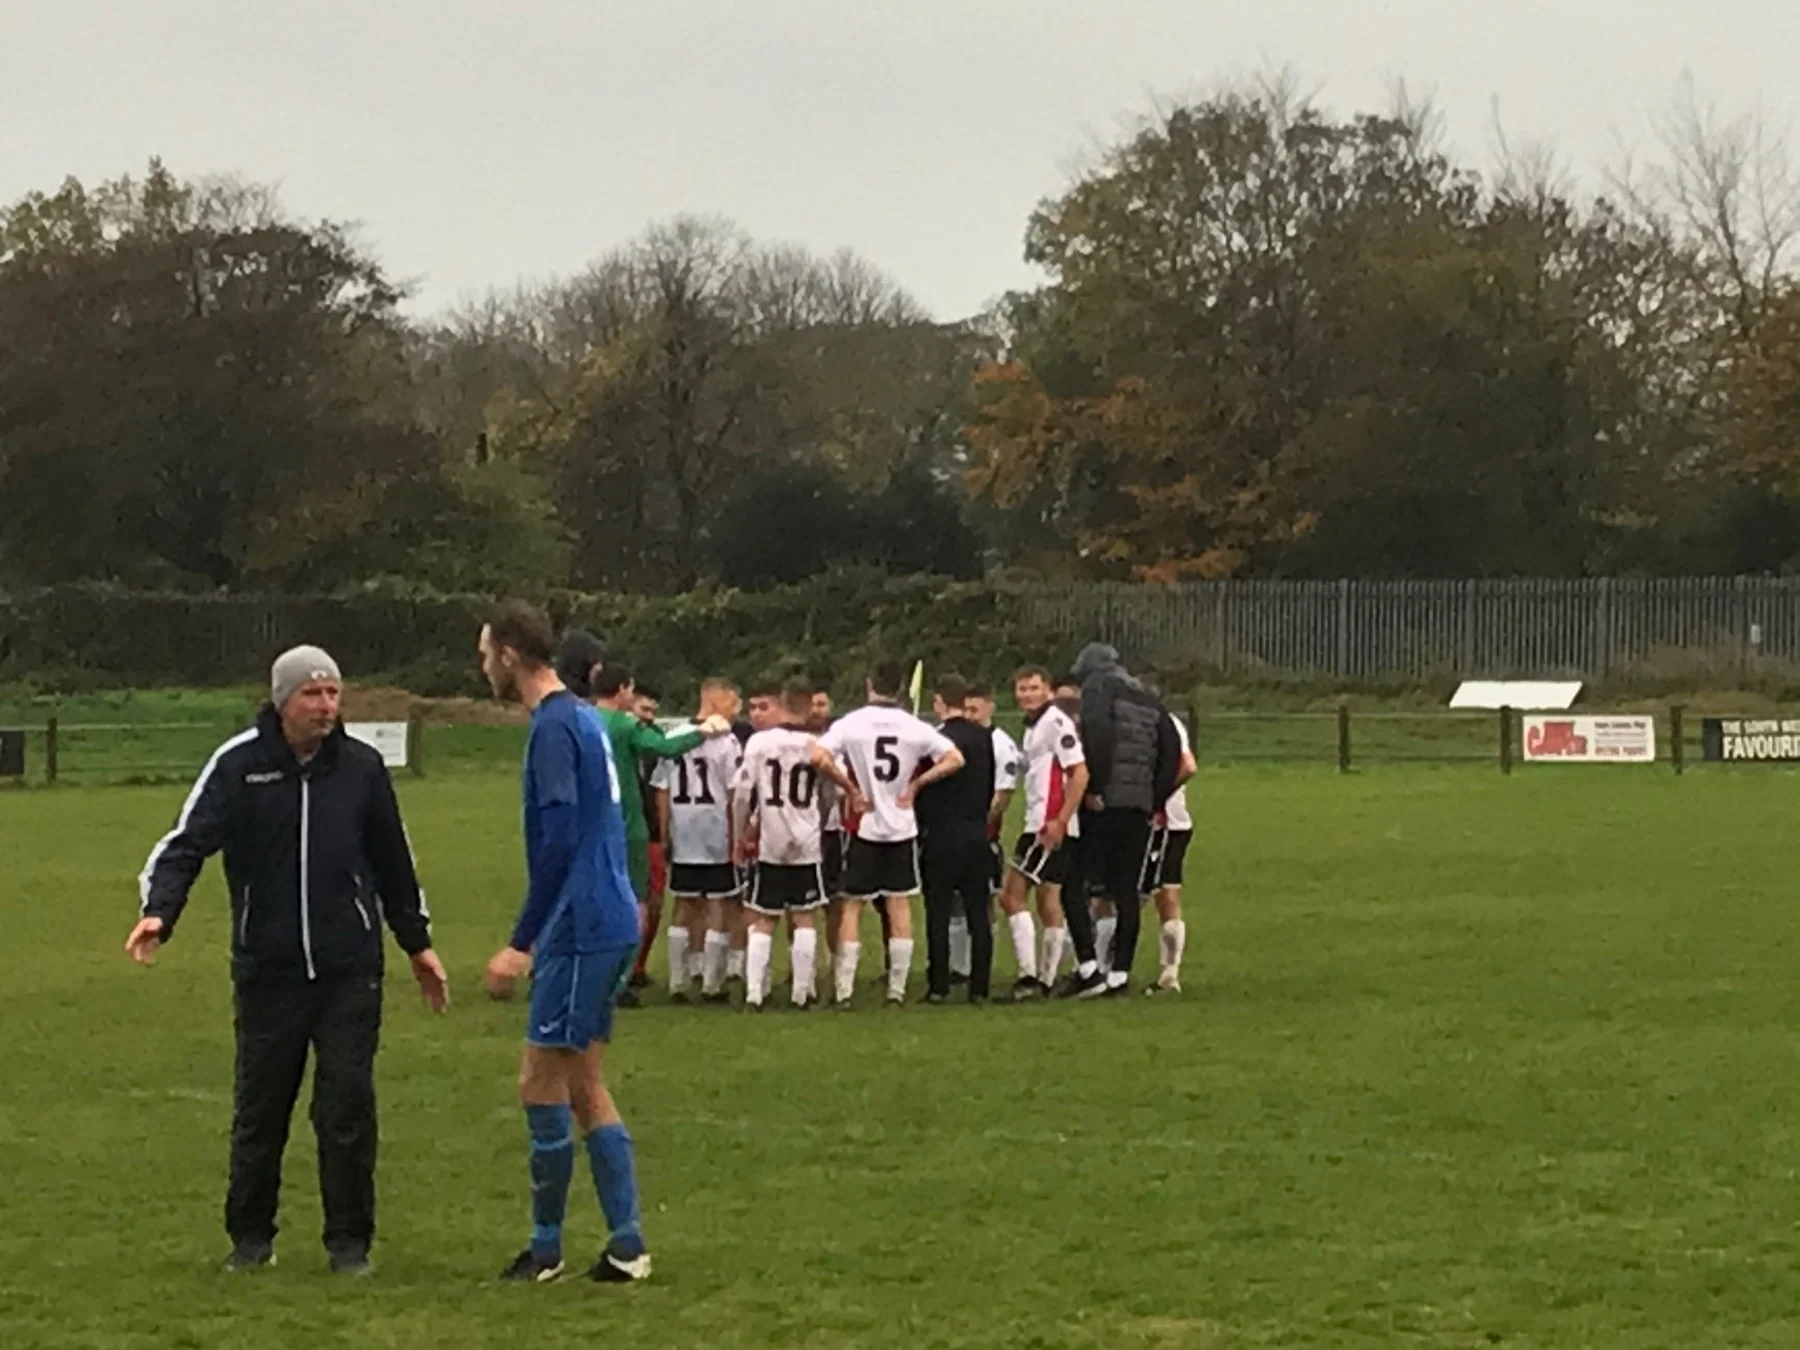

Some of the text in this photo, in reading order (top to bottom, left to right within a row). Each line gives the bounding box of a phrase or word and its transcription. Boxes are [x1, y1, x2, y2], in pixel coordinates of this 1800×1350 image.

[874, 735, 900, 782] 5
[1722, 735, 1800, 759] FAVOURI
[673, 755, 716, 805] 11
[765, 758, 817, 809] 10
